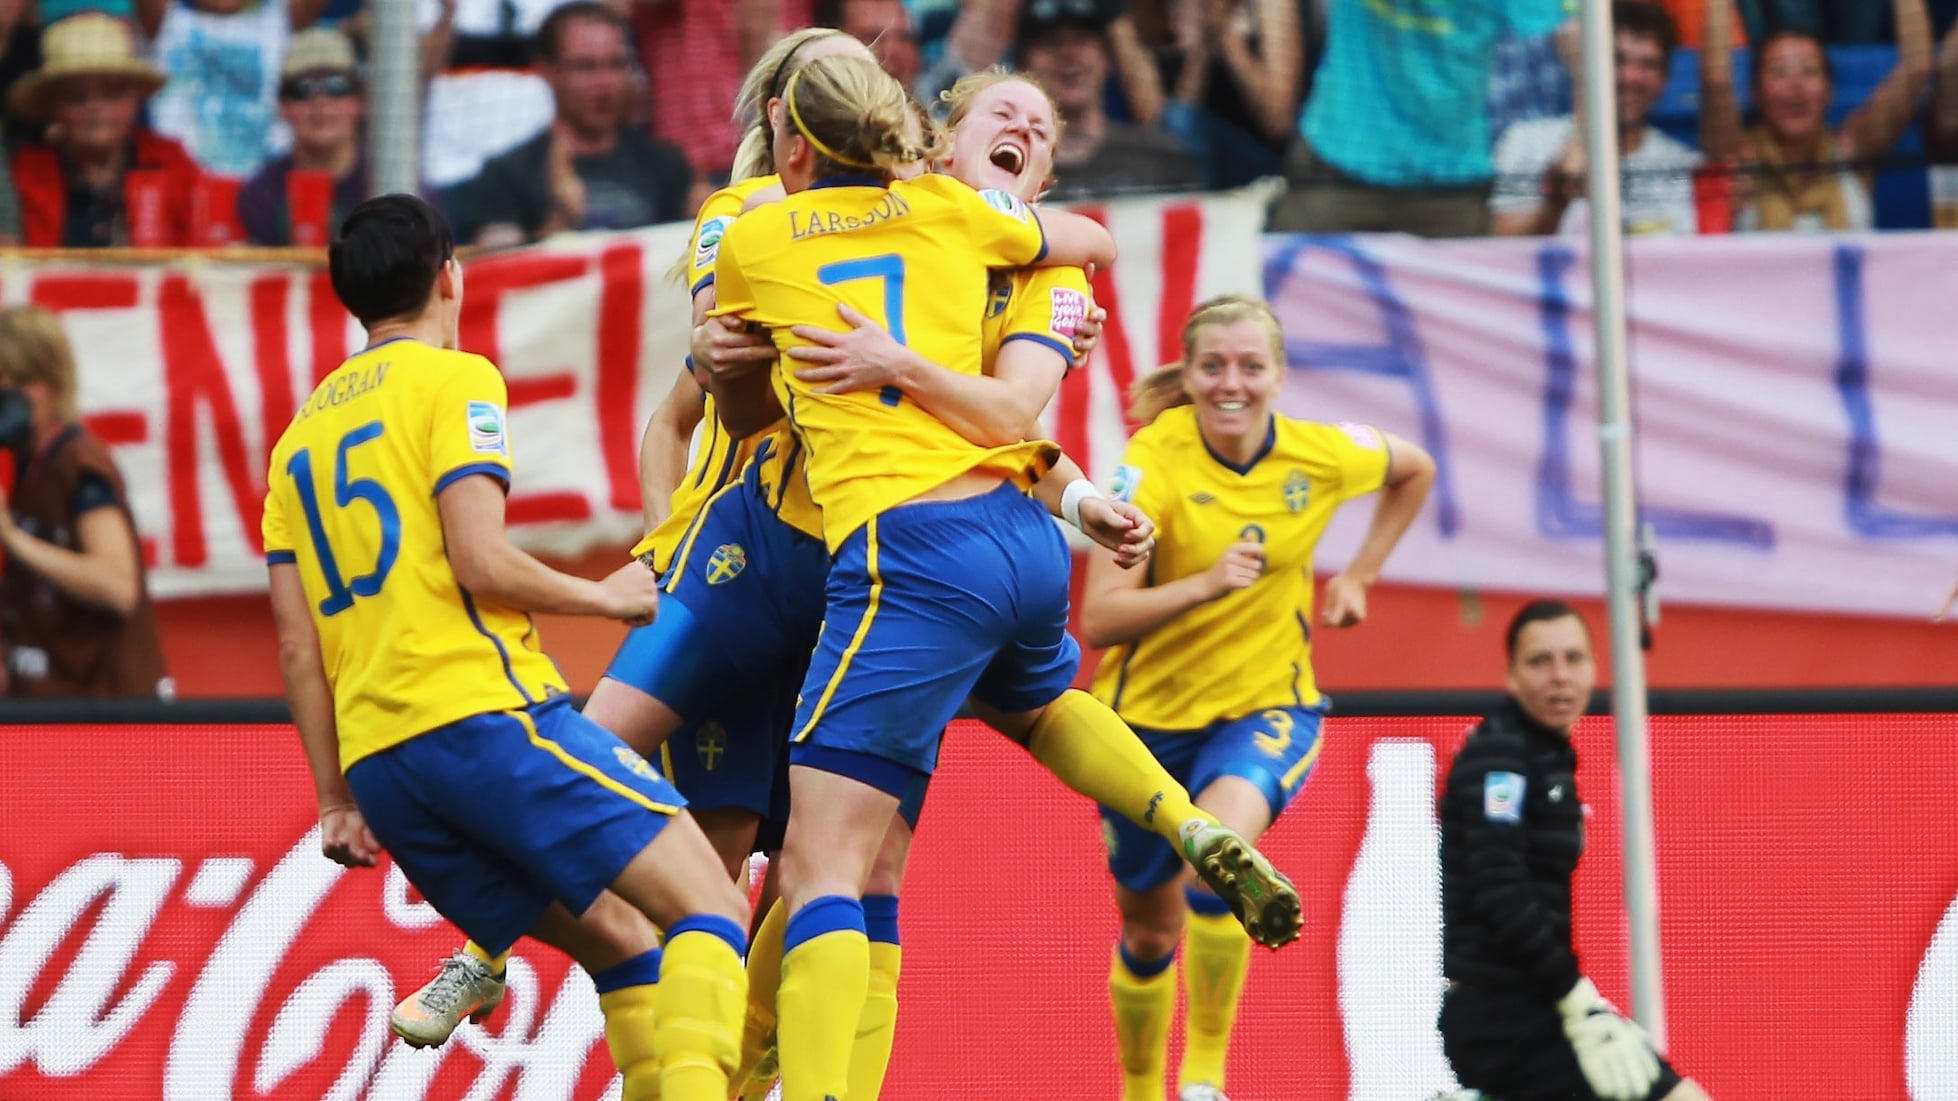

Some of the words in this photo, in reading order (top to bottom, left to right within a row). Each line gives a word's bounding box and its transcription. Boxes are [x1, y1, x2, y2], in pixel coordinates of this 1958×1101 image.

[1055, 292, 1081, 305] LIVE
[1055, 303, 1083, 319] YOUR
[817, 253, 906, 407] 7
[287, 419, 402, 617] 15
[1253, 709, 1295, 758] 3
